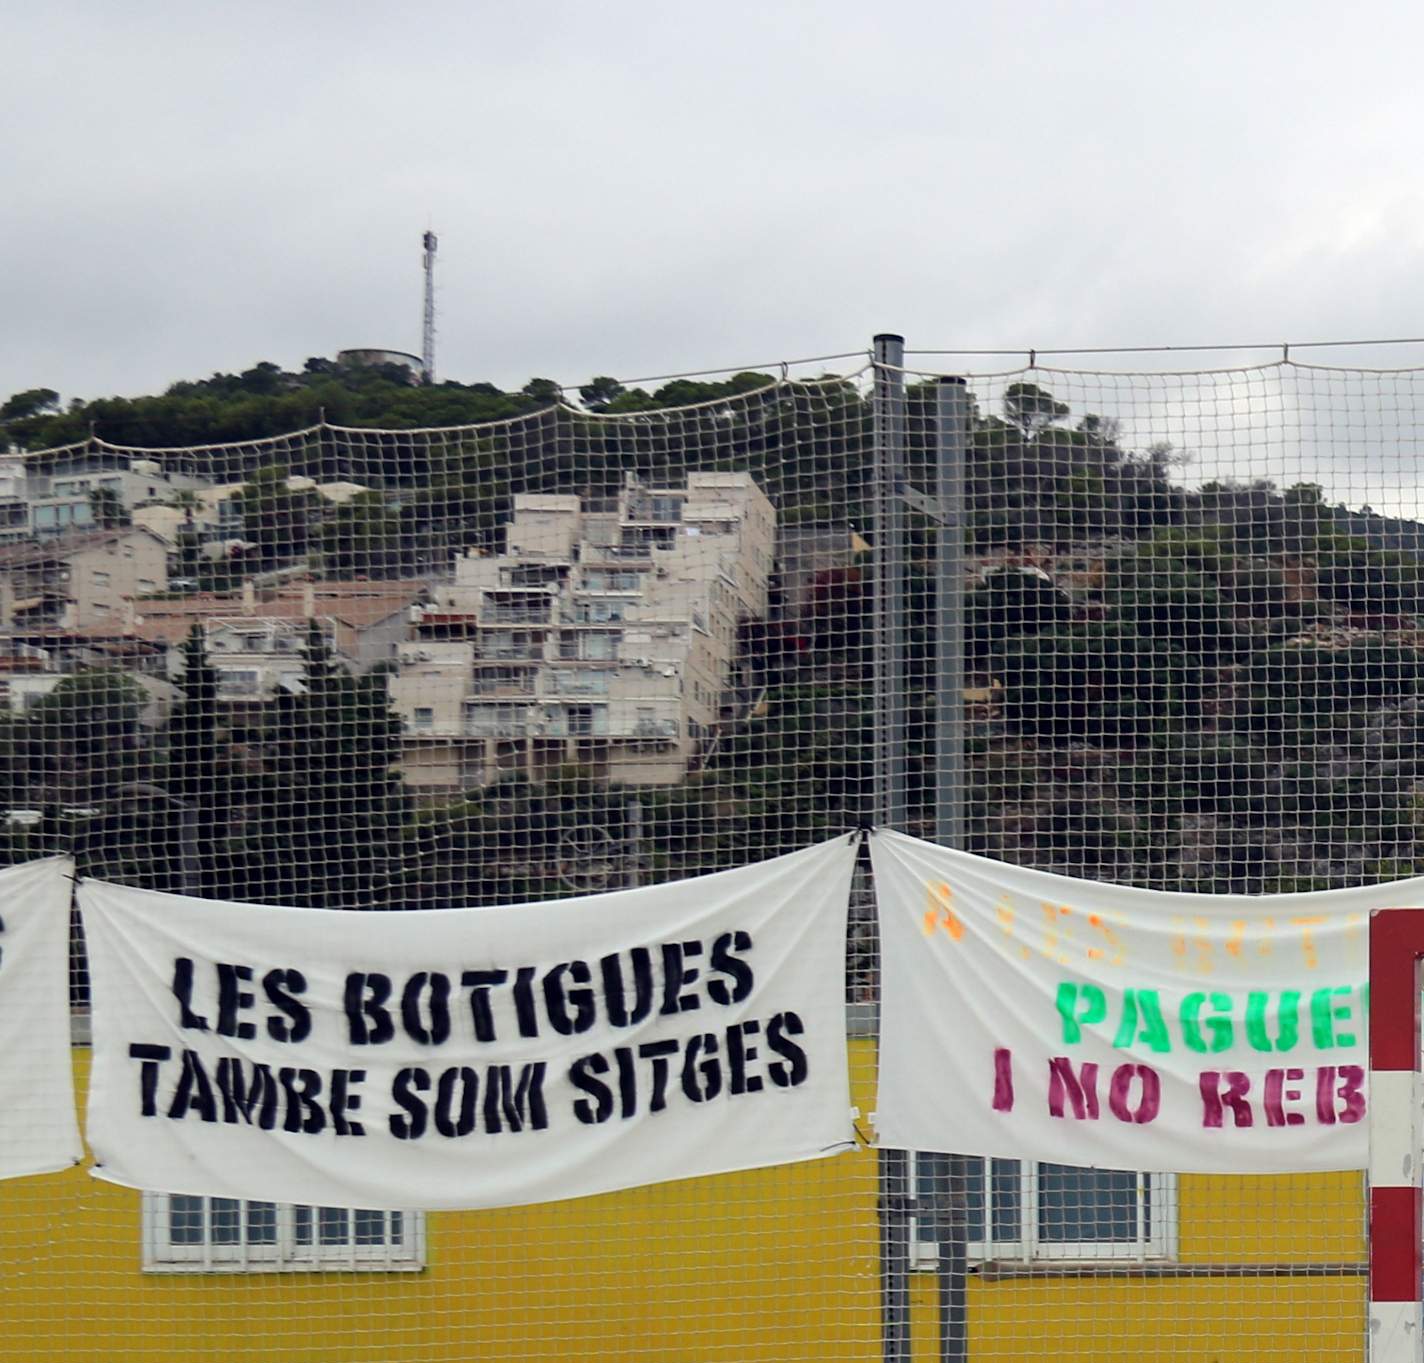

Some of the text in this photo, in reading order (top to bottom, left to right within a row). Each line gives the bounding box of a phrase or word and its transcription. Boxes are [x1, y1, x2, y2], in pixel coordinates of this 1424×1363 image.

[173, 930, 755, 1046] LES BOTIGUES
[129, 1011, 808, 1140] TAMBE SOM SITGES
[992, 1047, 1015, 1112] I
[1048, 1056, 1161, 1124] NO
